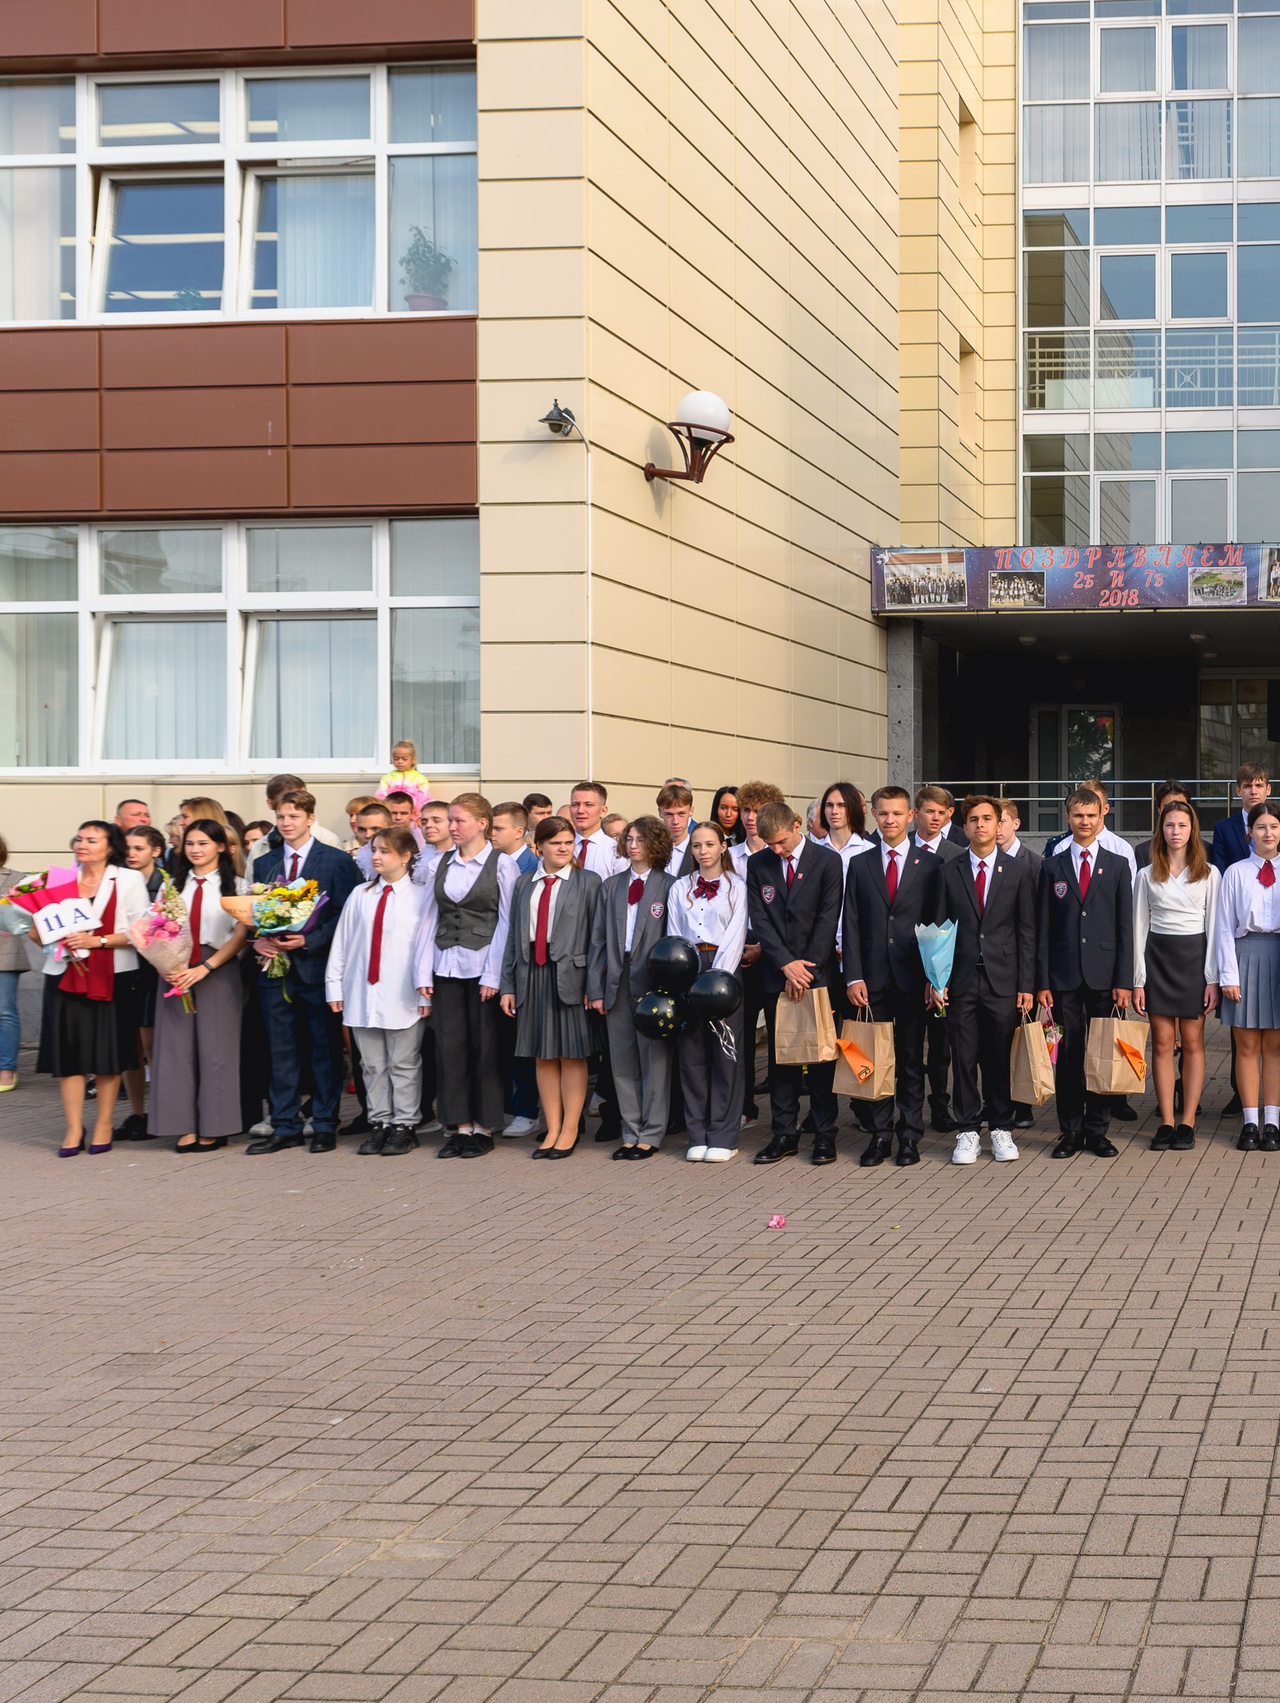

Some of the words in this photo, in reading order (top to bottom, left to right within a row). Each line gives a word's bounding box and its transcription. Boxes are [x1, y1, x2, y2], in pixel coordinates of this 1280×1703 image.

[995, 545, 1245, 570] ПОЗДРАВЛЯЕМ
[1109, 570, 1125, 588] И
[1098, 588, 1139, 607] 2018
[42, 913, 65, 933] 11
[72, 907, 91, 925] А
